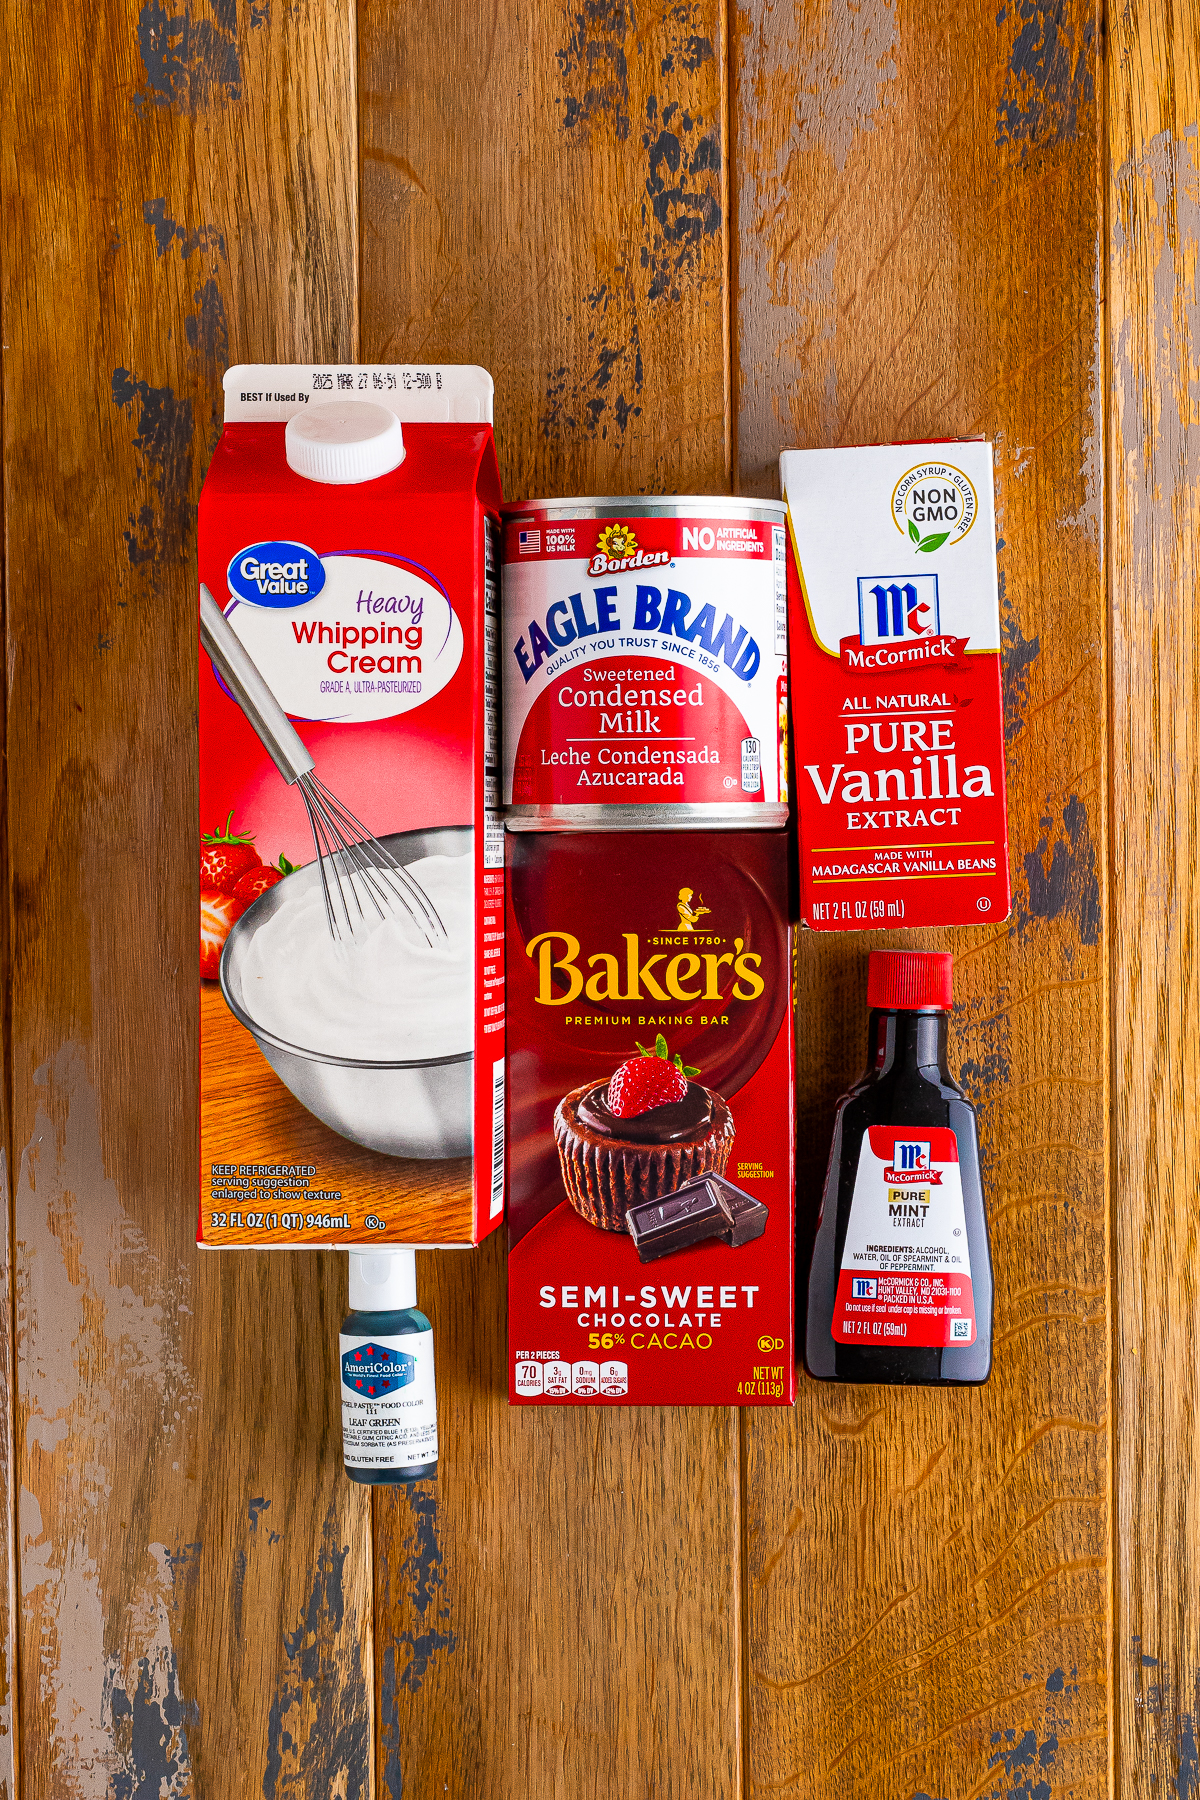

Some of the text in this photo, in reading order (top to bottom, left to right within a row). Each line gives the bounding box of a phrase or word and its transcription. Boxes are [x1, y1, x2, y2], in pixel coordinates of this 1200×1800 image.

[358, 373, 368, 389] 27
[240, 393, 310, 403] BEST If Used By
[895, 467, 973, 533] NO CORN SYRUP GLUTEN FREE
[913, 488, 956, 505] NON
[913, 506, 957, 522] GMO
[546, 535, 575, 544] 100%
[682, 526, 715, 551] NO
[716, 528, 758, 540] ARTIFICIAL
[716, 540, 765, 553] INGREDIENTS
[589, 550, 669, 574] Borden
[240, 557, 309, 582] Great
[256, 578, 309, 595] Value
[356, 590, 423, 624] Heavy
[291, 622, 422, 650] Whipping
[513, 586, 621, 685] EAGLE
[633, 585, 761, 682] BRAND
[546, 638, 720, 676] QUALITY YOU TRUST SINCE 1856
[845, 639, 955, 668] McCormick
[327, 650, 422, 673] Cream
[583, 666, 675, 682] Sweetened
[320, 681, 422, 694] GRADE A, ULTRA-PASTEURIZED
[558, 683, 704, 708] Condensed
[842, 693, 951, 710] ALL NATURAL
[598, 710, 661, 734] Milk
[844, 720, 956, 755] PURE
[746, 740, 756, 753] 130
[540, 746, 720, 766] Leche Condensada
[576, 768, 684, 786] Azucarada
[804, 754, 995, 805] Vanilla
[846, 808, 962, 830] EXTRACT
[874, 850, 933, 860] MADE WITH
[811, 858, 997, 877] MADAGASCAR VANILLA BEANS
[812, 899, 905, 921] NET 2 FL OZ (59 mL)
[652, 936, 721, 945] SINCE 1780
[525, 931, 765, 1006] Baker's
[565, 1016, 729, 1025] PREMIUM BAKING BAR
[212, 1165, 316, 1176] KEEP REFRIGERATED
[886, 1171, 936, 1182] McCormick
[212, 1176, 309, 1189] serving suggestion
[211, 1189, 341, 1201] enlarged to show texture
[893, 1191, 926, 1201] PURE
[888, 1204, 930, 1218] MINT
[211, 1213, 350, 1230] 32 FL OZ (1 QT) 946mL
[893, 1218, 925, 1228] EXTRACT
[866, 1245, 915, 1253] INGREDIENTS:
[853, 1253, 878, 1262] WATER,
[892, 1254, 901, 1262] OF
[903, 1255, 944, 1263] SPEARMINT
[951, 1255, 962, 1263] OIL
[879, 1262, 935, 1272] OF PEPPERMINT.
[878, 1277, 913, 1286] McCORMICK
[920, 1279, 931, 1287] CO.,
[933, 1279, 944, 1287] INC.
[539, 1285, 759, 1309] SEMI-SWEET
[878, 1286, 894, 1294] HUNT
[895, 1287, 918, 1296] VALLEY,
[931, 1288, 962, 1296] 21031-1100
[883, 1295, 907, 1304] PACKED
[916, 1296, 934, 1304] U.S.A.
[845, 1303, 852, 1311] Do
[852, 1304, 861, 1312] not
[862, 1304, 871, 1312] use
[872, 1304, 876, 1312] if
[876, 1304, 886, 1312] seal
[888, 1305, 903, 1313] under
[903, 1306, 913, 1315] cap
[913, 1305, 918, 1313] is
[919, 1306, 938, 1316] missing
[944, 1306, 962, 1315] broken.
[577, 1313, 722, 1328] CHOCOLATE
[843, 1320, 907, 1337] NET 2 FL OZ (59mL)
[588, 1332, 713, 1350] 56% CACAO
[515, 1351, 560, 1359] PER 2 PIECES
[345, 1362, 407, 1373] AmeriColor
[522, 1366, 536, 1378] 70
[553, 1367, 562, 1376] 3g
[579, 1367, 592, 1376] 0mg
[609, 1367, 618, 1376] 6g
[753, 1366, 785, 1380] NET WT
[737, 1381, 784, 1398] 4 OZ (113g)
[402, 1399, 423, 1407] COLOR
[349, 1418, 401, 1427] LEAF GREEN
